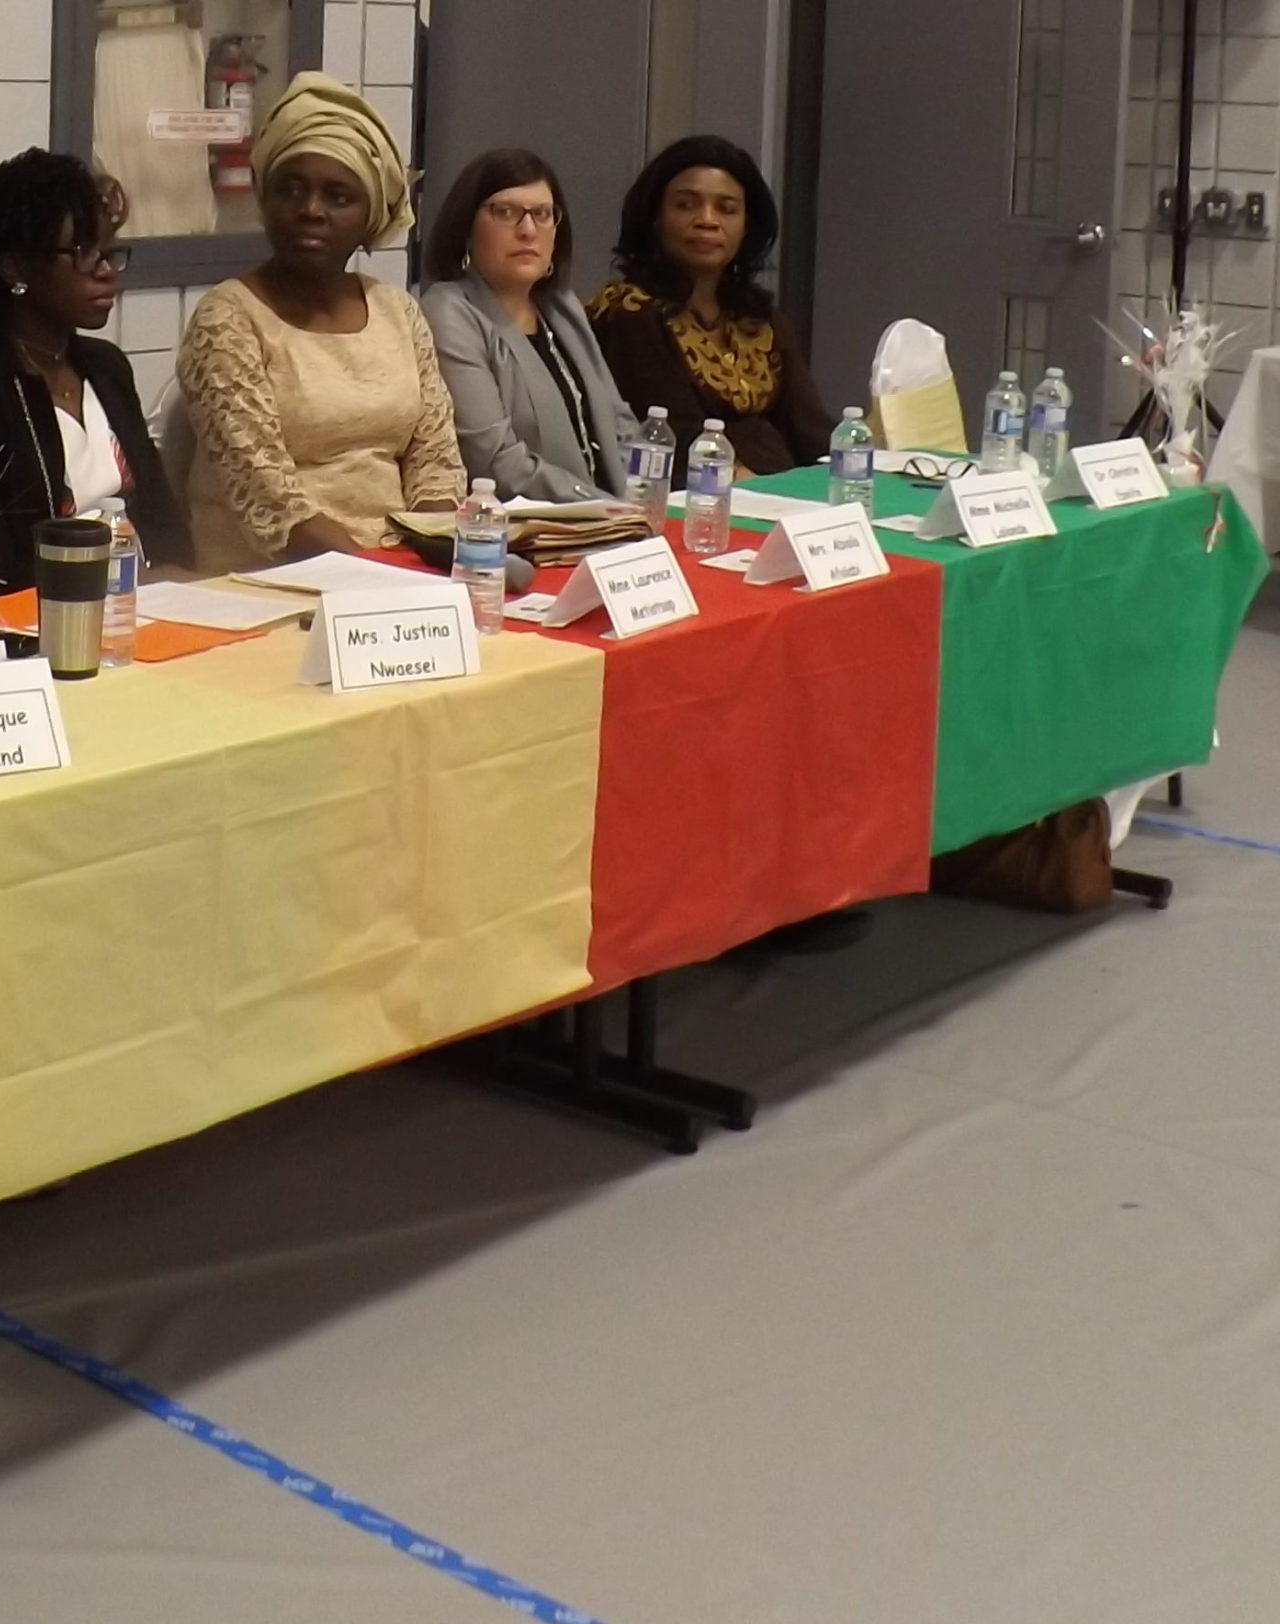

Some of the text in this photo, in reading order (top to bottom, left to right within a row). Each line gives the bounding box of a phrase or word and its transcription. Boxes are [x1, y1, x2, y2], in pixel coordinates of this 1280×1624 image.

[347, 622, 451, 647] Mrs. Justina
[370, 656, 437, 680] Nwaesei
